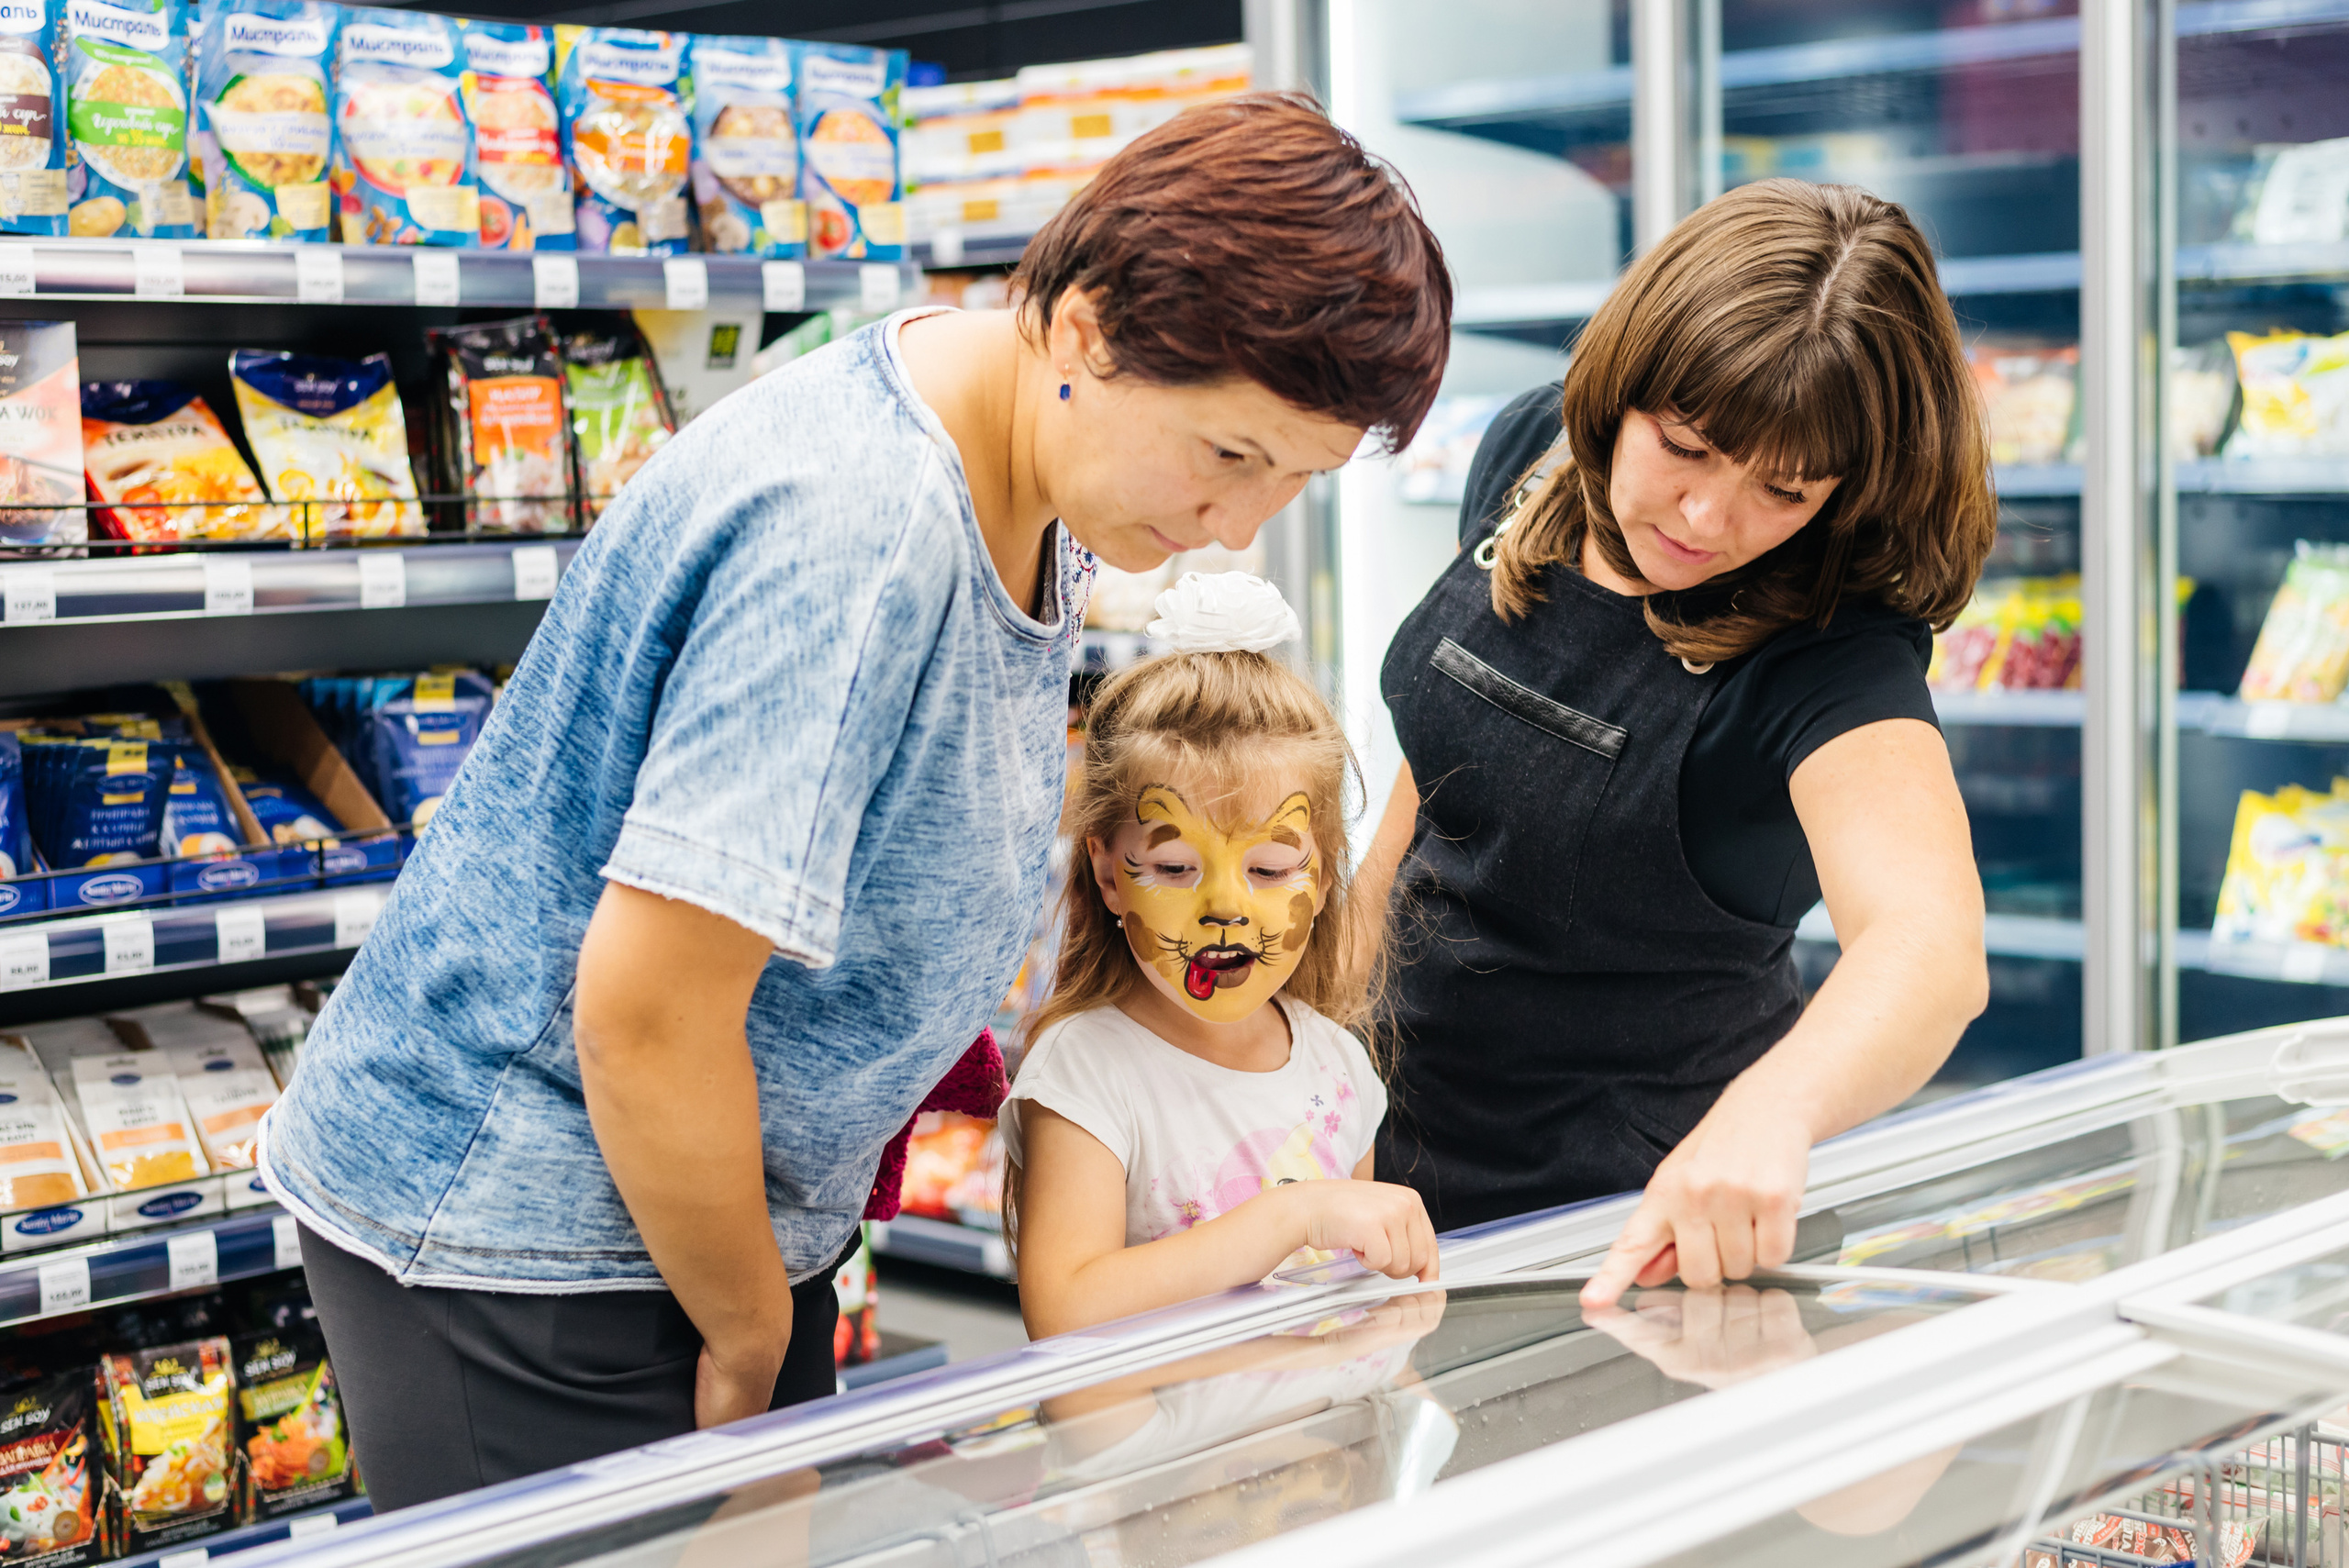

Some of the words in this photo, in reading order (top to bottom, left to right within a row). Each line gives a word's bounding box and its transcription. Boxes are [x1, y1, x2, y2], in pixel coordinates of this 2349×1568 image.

[74, 10, 161, 38] Мистраль
[232, 26, 318, 45] Мистраль
[350, 37, 442, 57] Мистраль
[20, 1217, 50, 1230] Santa
[50, 1212, 79, 1226] Maria
[243, 1358, 272, 1378] SEN
[270, 1349, 297, 1371] SOY
[144, 1375, 171, 1392] SEN
[0, 1414, 24, 1434] SEN
[24, 1407, 51, 1426] SOY
